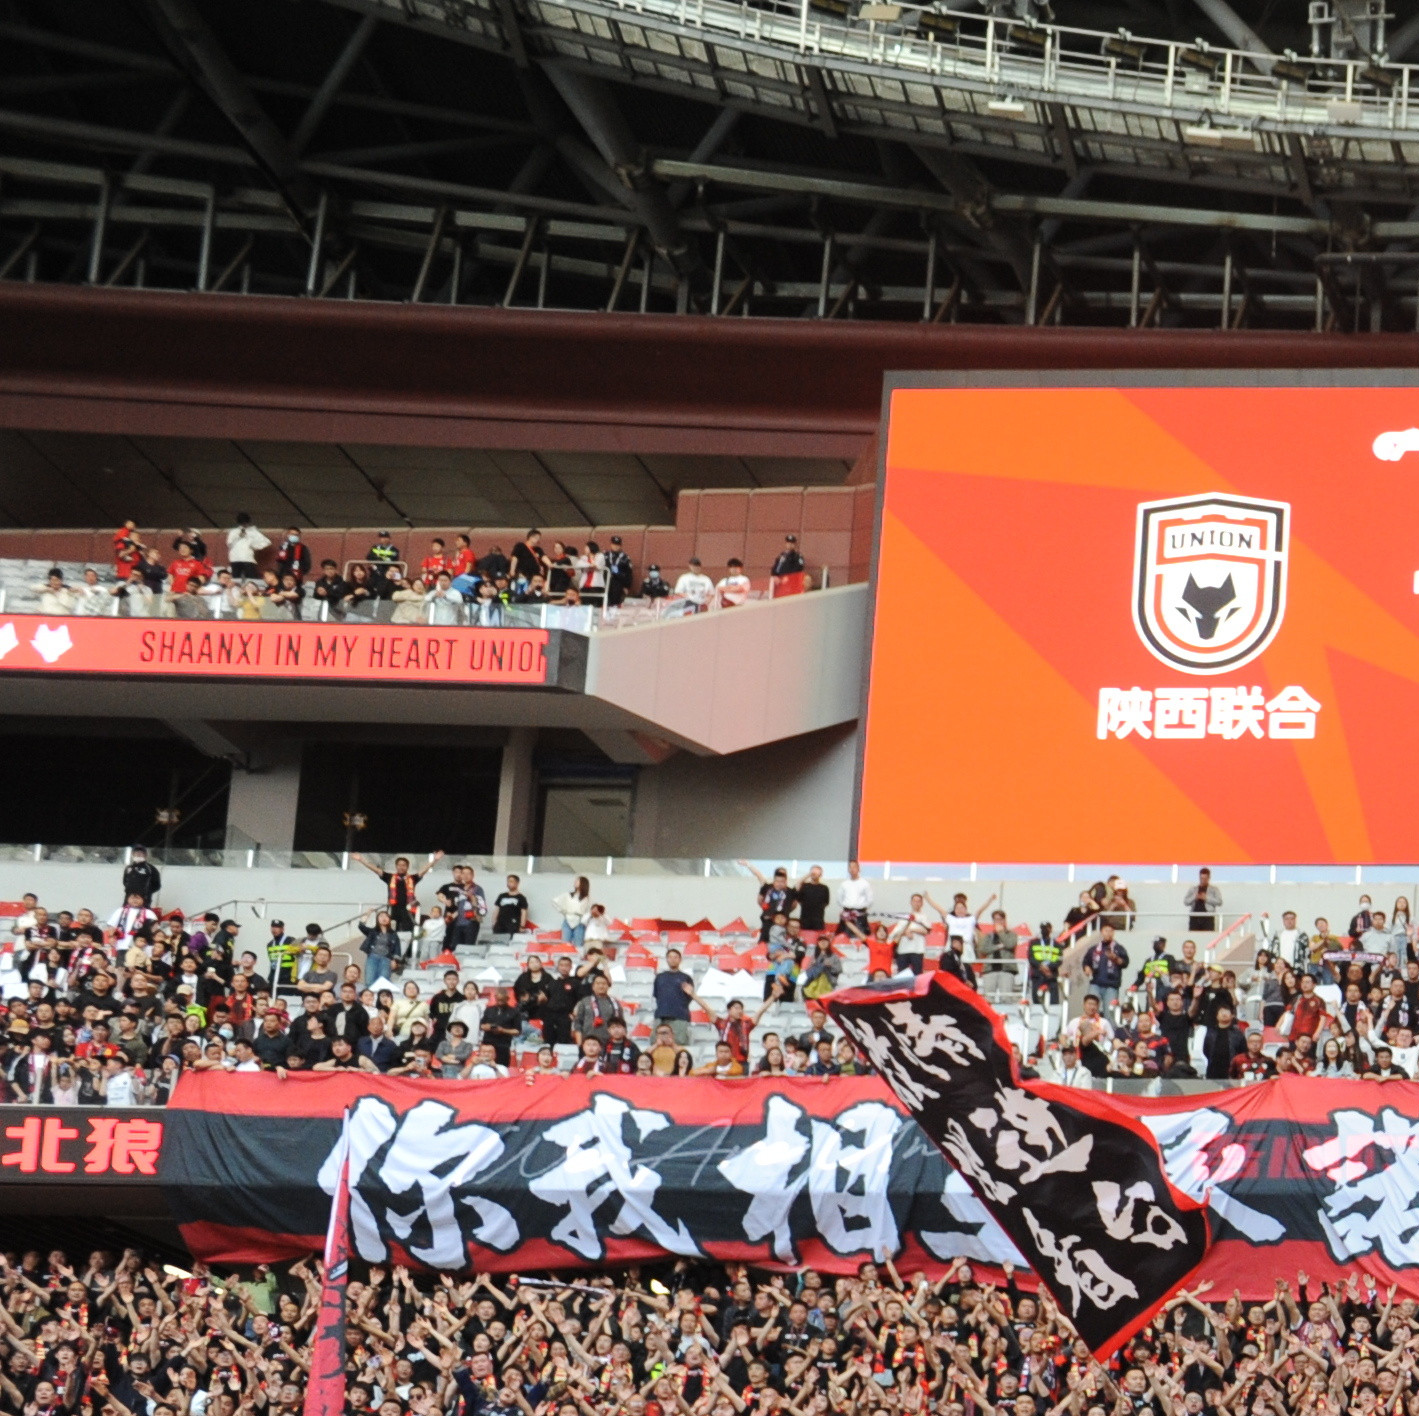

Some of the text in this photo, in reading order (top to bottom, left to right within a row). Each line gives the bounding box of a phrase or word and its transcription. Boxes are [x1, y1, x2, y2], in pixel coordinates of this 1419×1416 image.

[1171, 529, 1253, 550] UNION
[140, 630, 263, 664] SHAANXI
[275, 632, 302, 666] IN
[313, 634, 357, 668] MY
[370, 636, 457, 671] HEART
[1096, 685, 1322, 740] 陕西联合
